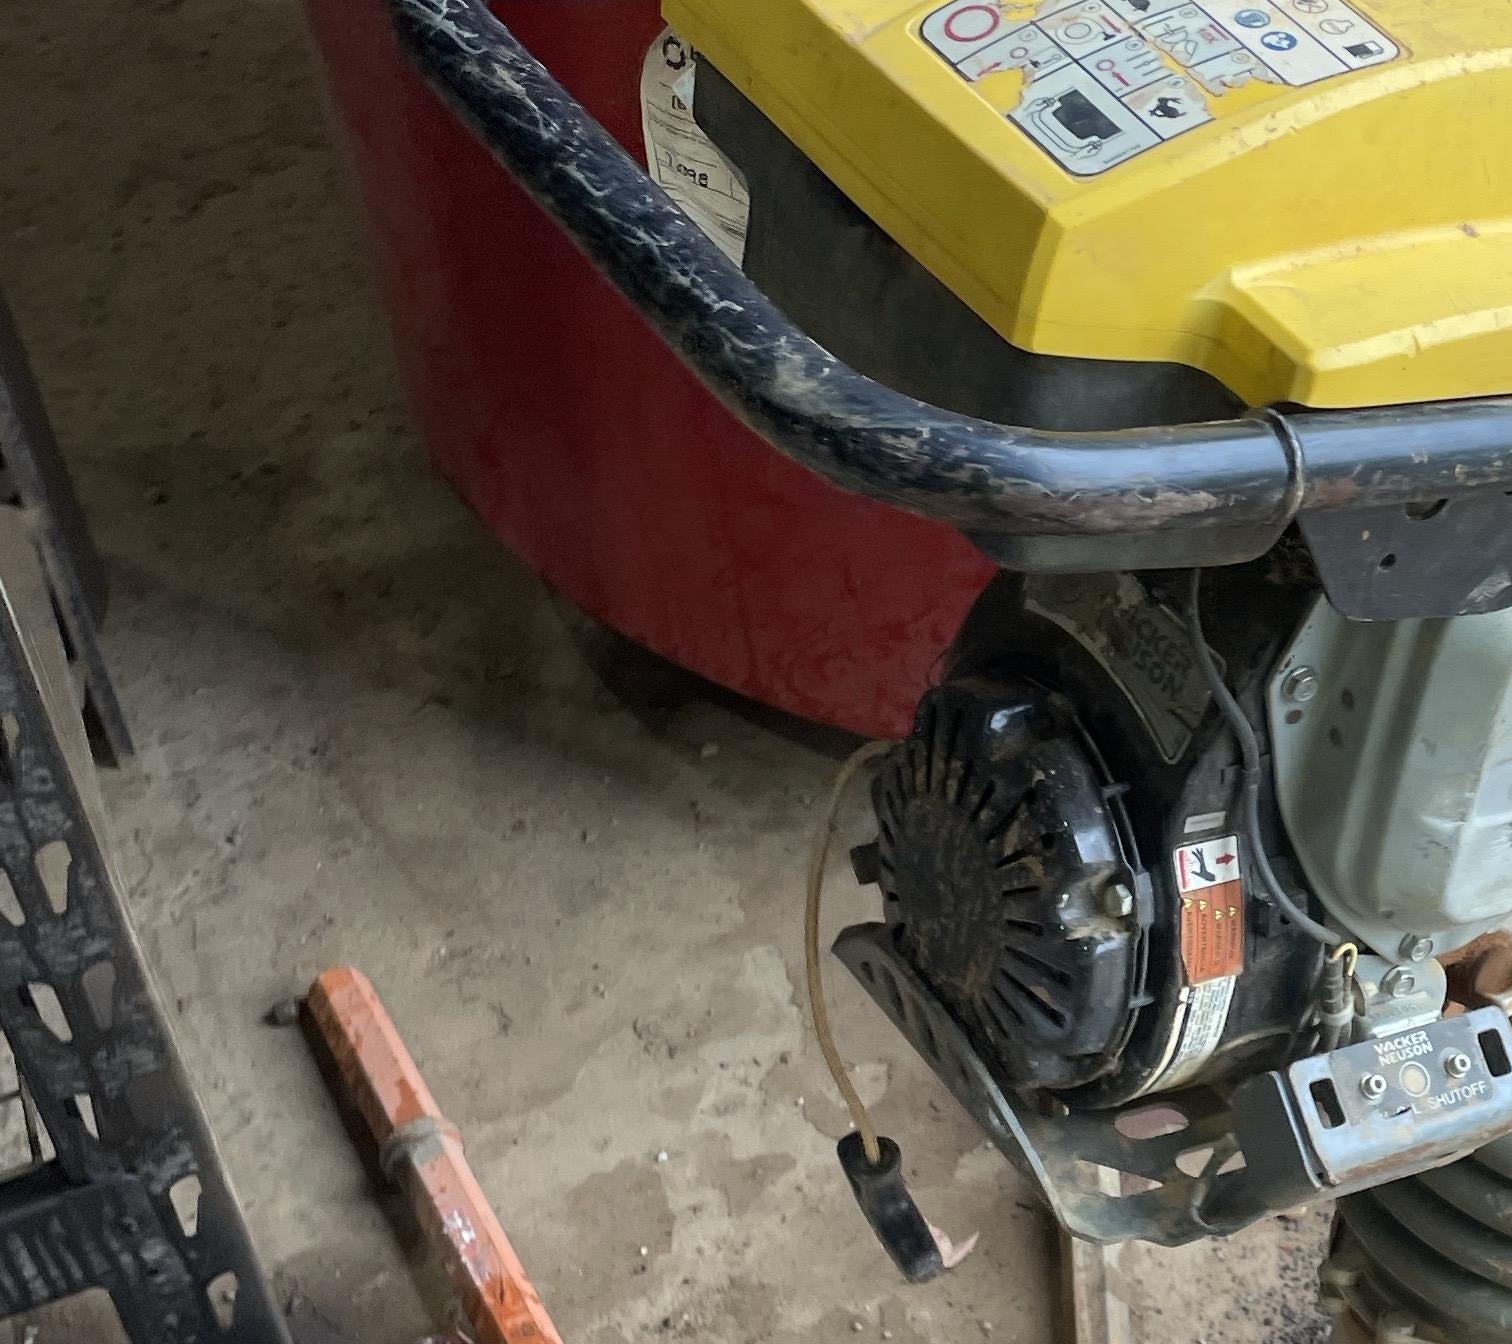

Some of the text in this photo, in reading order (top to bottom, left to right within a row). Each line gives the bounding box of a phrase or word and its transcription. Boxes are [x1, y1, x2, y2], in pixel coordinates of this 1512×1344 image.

[1373, 1030, 1430, 1056] WACKER
[1377, 1040, 1434, 1067] NEUSON
[1428, 1080, 1488, 1110] SHUTOFF
